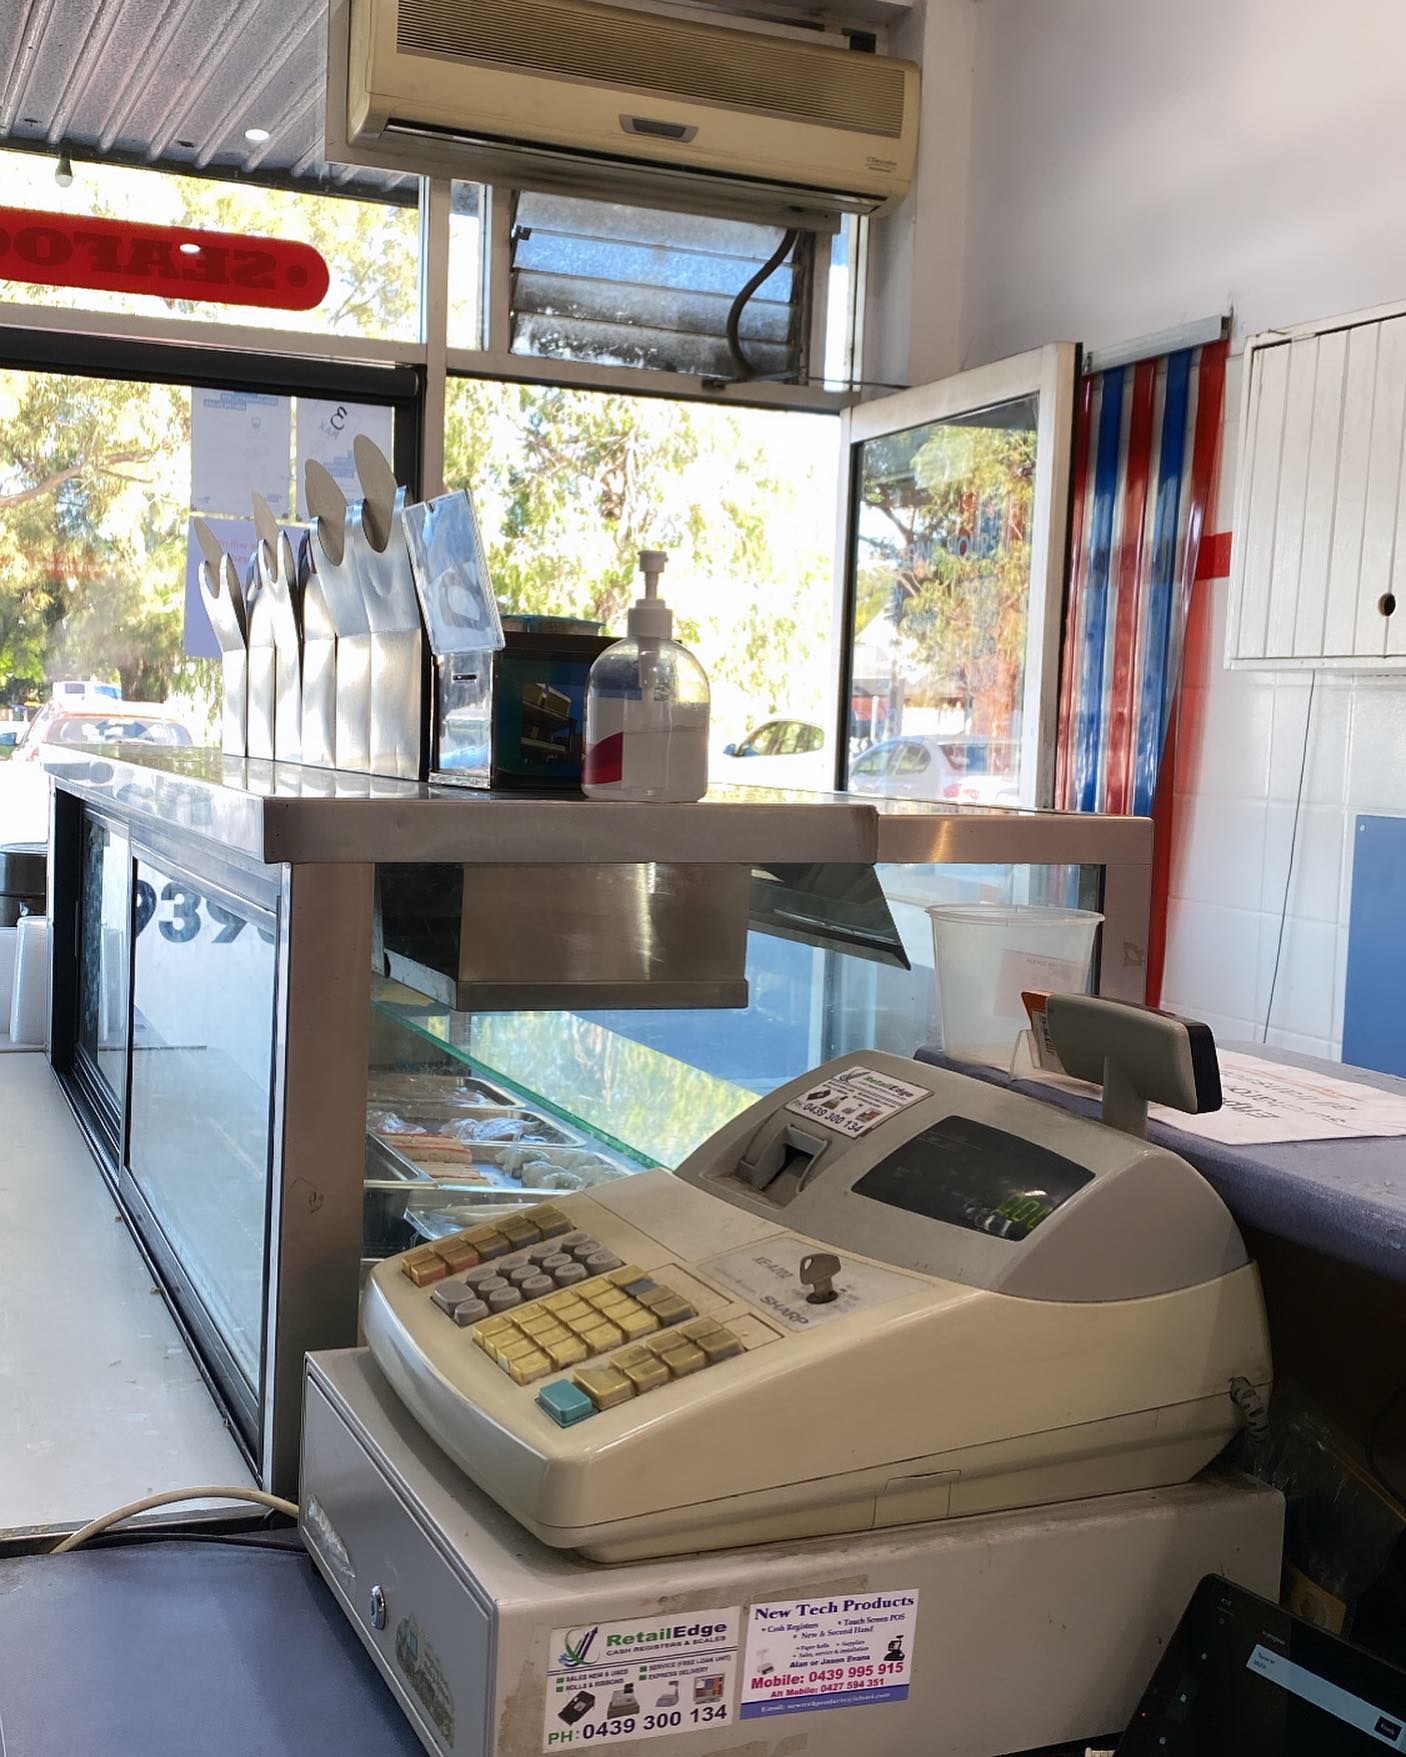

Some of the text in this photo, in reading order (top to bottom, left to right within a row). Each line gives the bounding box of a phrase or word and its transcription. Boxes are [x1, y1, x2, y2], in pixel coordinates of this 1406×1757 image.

[760, 1295, 809, 1324] SHARP
[755, 1597, 914, 1620] New Tech Products
[786, 1623, 819, 1632] Registers
[844, 1617, 865, 1626] Touch
[890, 1613, 905, 1621] POS
[607, 1623, 727, 1647] RetailEdge
[801, 1631, 818, 1639] New
[827, 1627, 852, 1636] Second
[854, 1625, 874, 1633] Hand
[606, 1648, 631, 1656] CASH
[633, 1641, 682, 1652] REGISTERS
[692, 1635, 727, 1645] SCALES
[648, 1662, 677, 1671] SERVICE
[789, 1660, 808, 1668] Alan
[566, 1674, 587, 1682] SALES
[588, 1671, 604, 1679] NEW
[648, 1666, 709, 1680] EXPRESS DELIVERY
[751, 1662, 904, 1689] Mobile: 0439 995 915
[786, 1687, 818, 1696] Mobile:
[820, 1682, 844, 1692] 0427
[847, 1680, 864, 1689] 594
[867, 1678, 884, 1687] 351
[548, 1704, 727, 1745] PH: 0439 300 134
